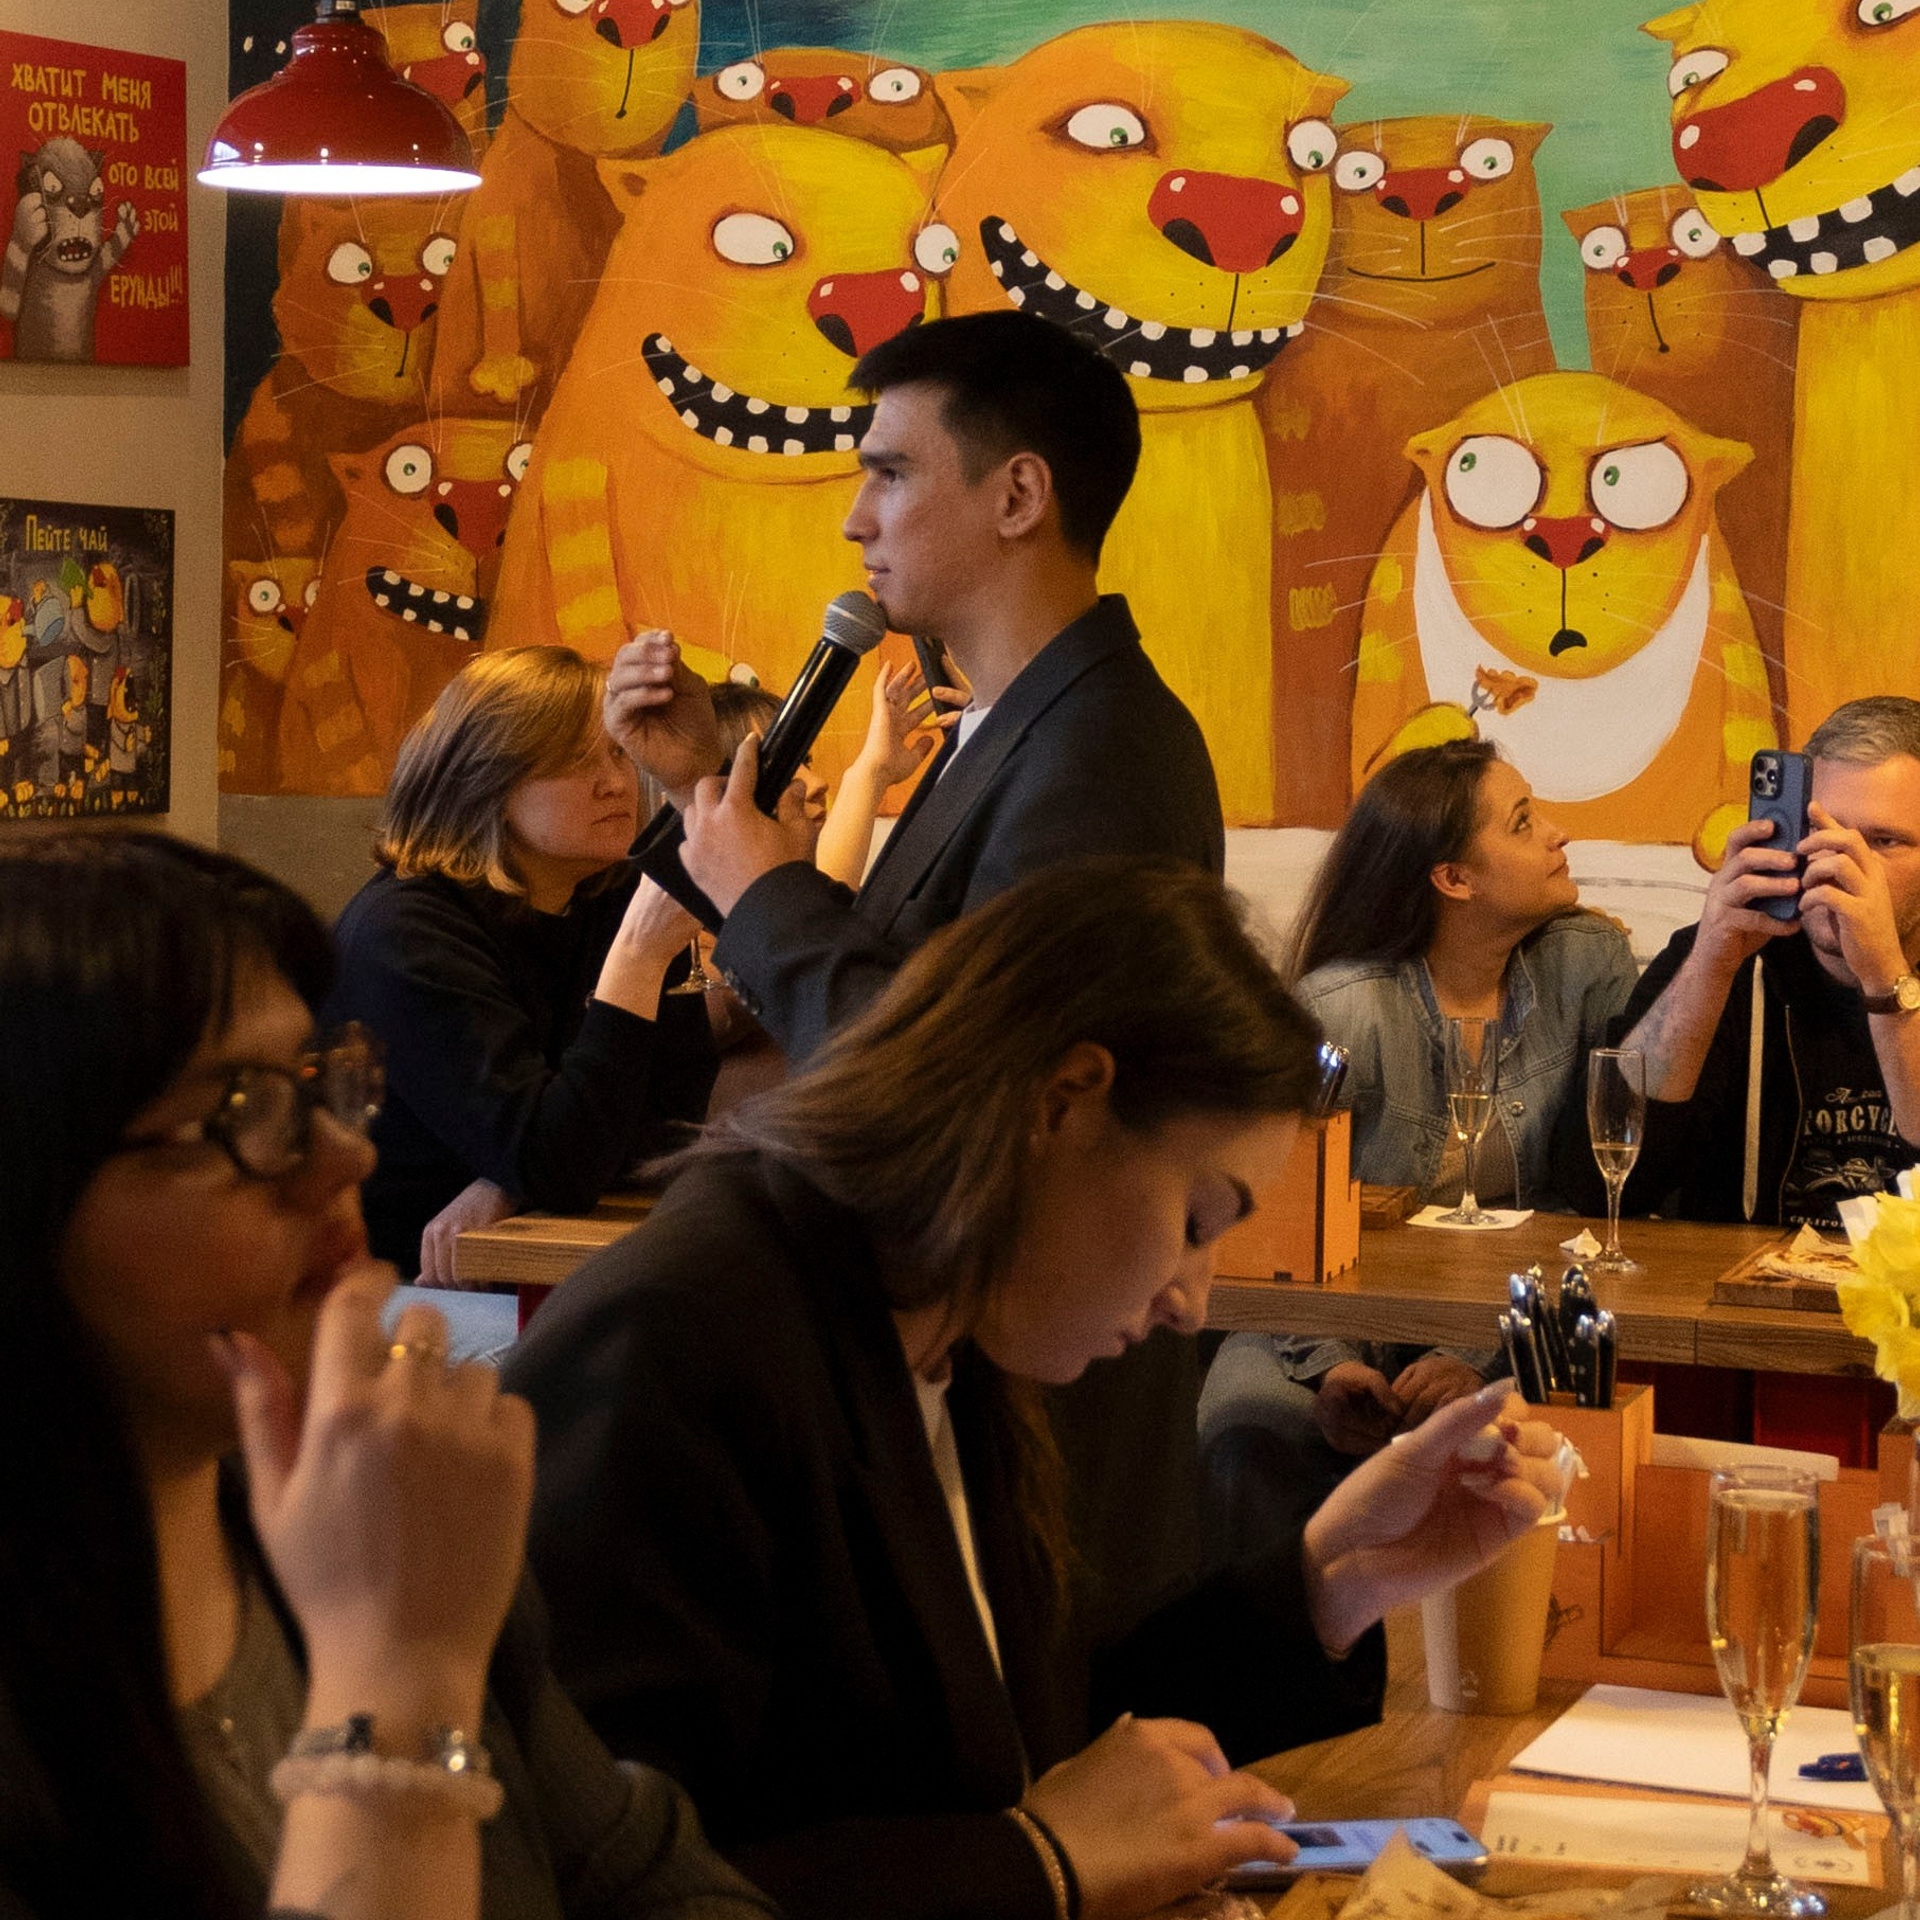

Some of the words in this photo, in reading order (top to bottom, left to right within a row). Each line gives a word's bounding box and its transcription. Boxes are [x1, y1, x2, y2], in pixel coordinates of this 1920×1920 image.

[11, 63, 87, 98] ХВАТИТ
[102, 71, 152, 110] МЕНЯ
[28, 101, 140, 143] ОТВЛЕКАТЬ
[144, 158, 179, 191] ВСЕЙ
[144, 203, 179, 232] ЭТОЙ
